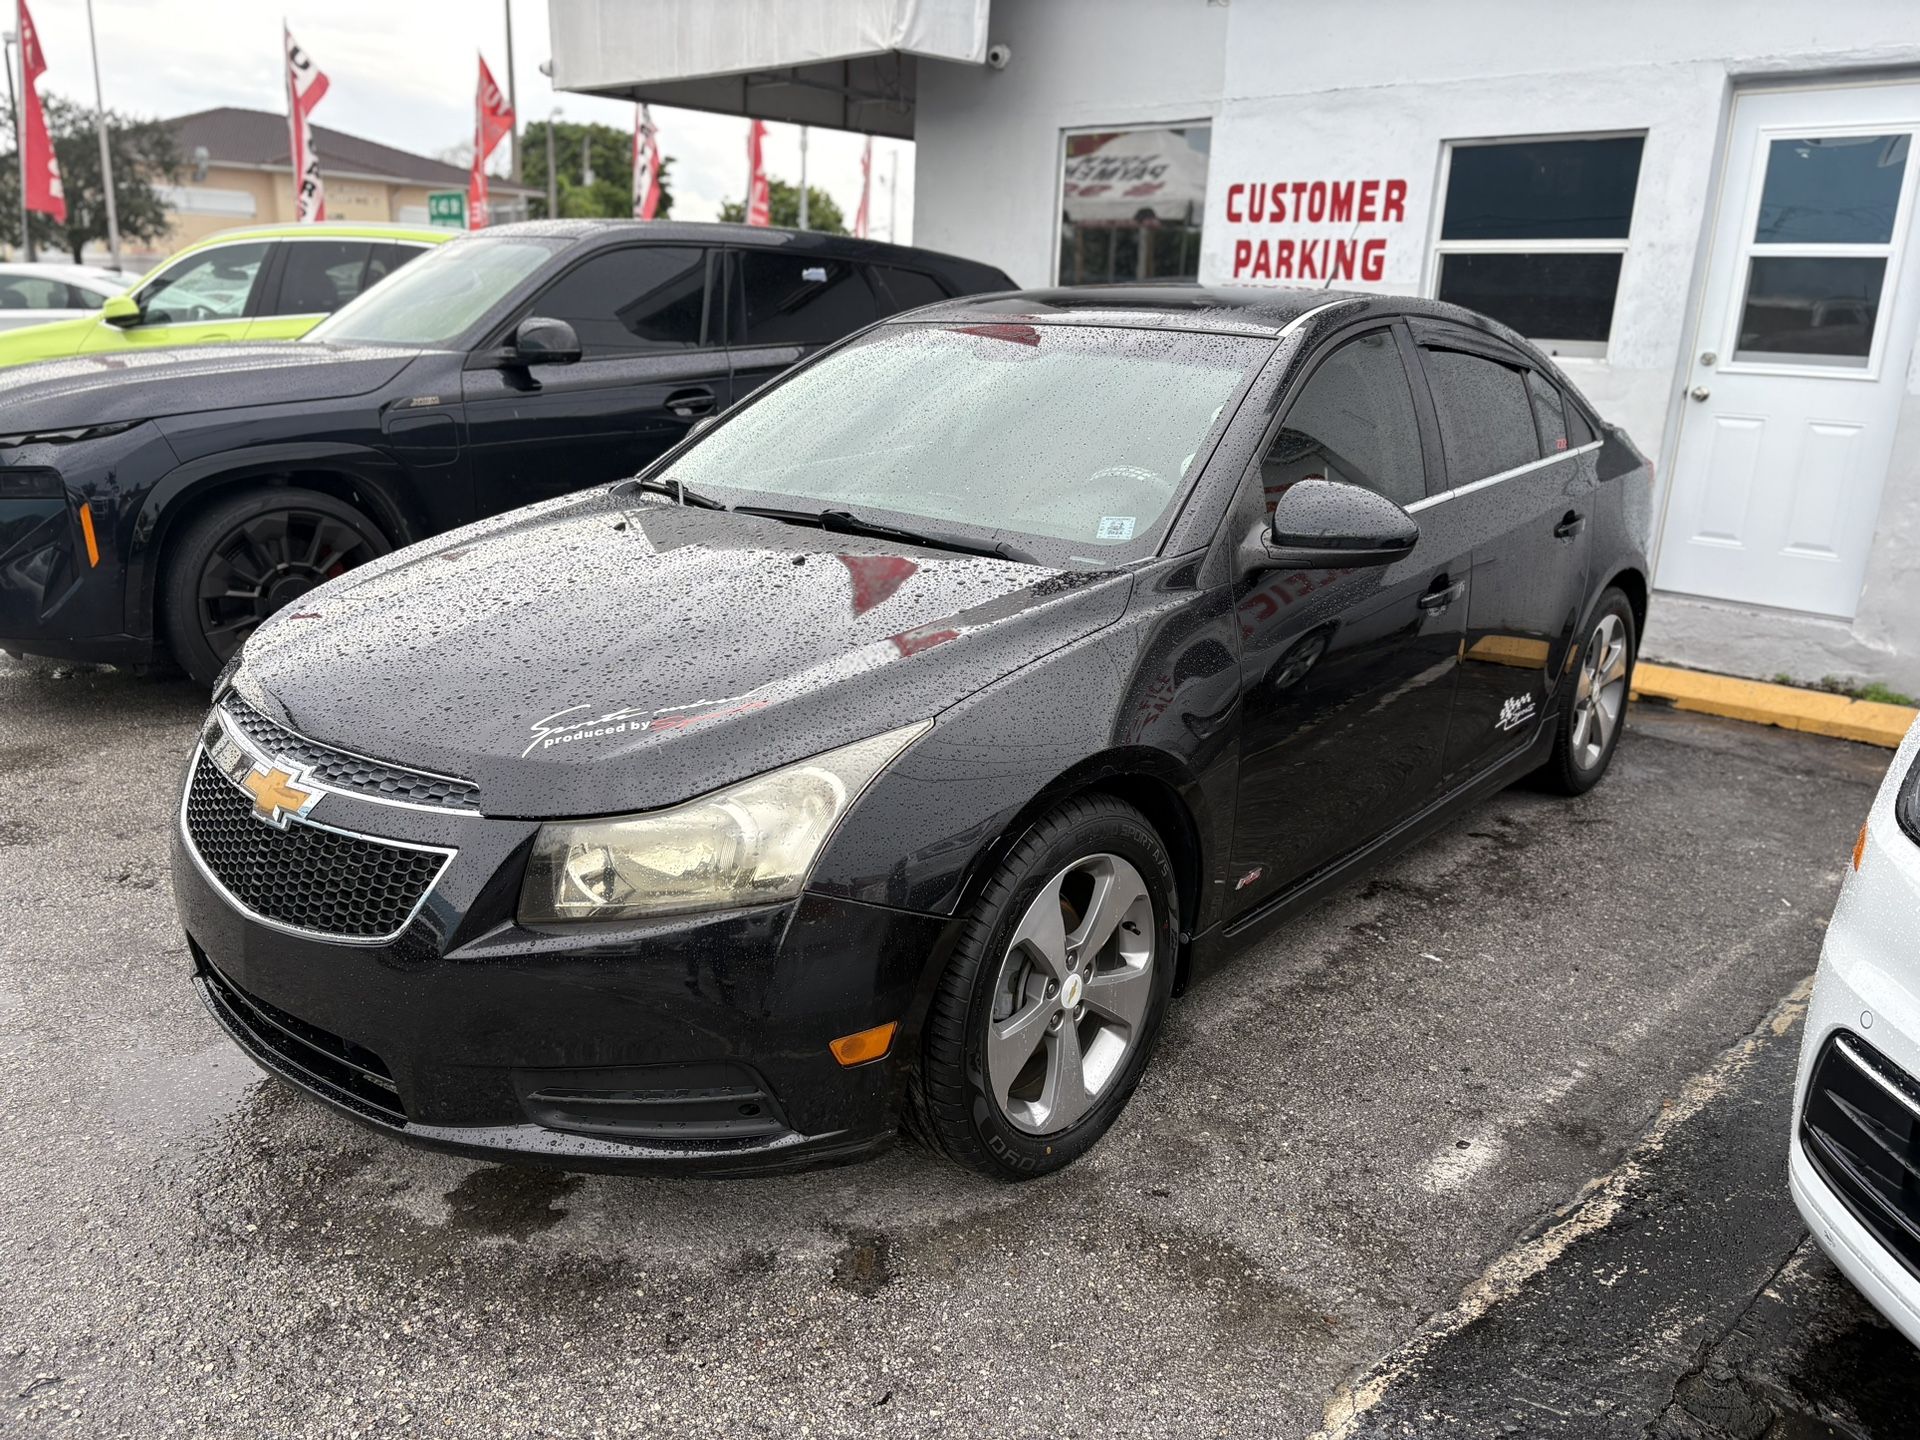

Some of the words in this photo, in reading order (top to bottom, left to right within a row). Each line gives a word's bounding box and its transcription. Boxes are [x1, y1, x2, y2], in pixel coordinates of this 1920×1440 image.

[1226, 179, 1408, 223] CUSTOMER
[1234, 239, 1387, 281] PARKING
[543, 723, 626, 749] produced
[630, 719, 651, 731] by
